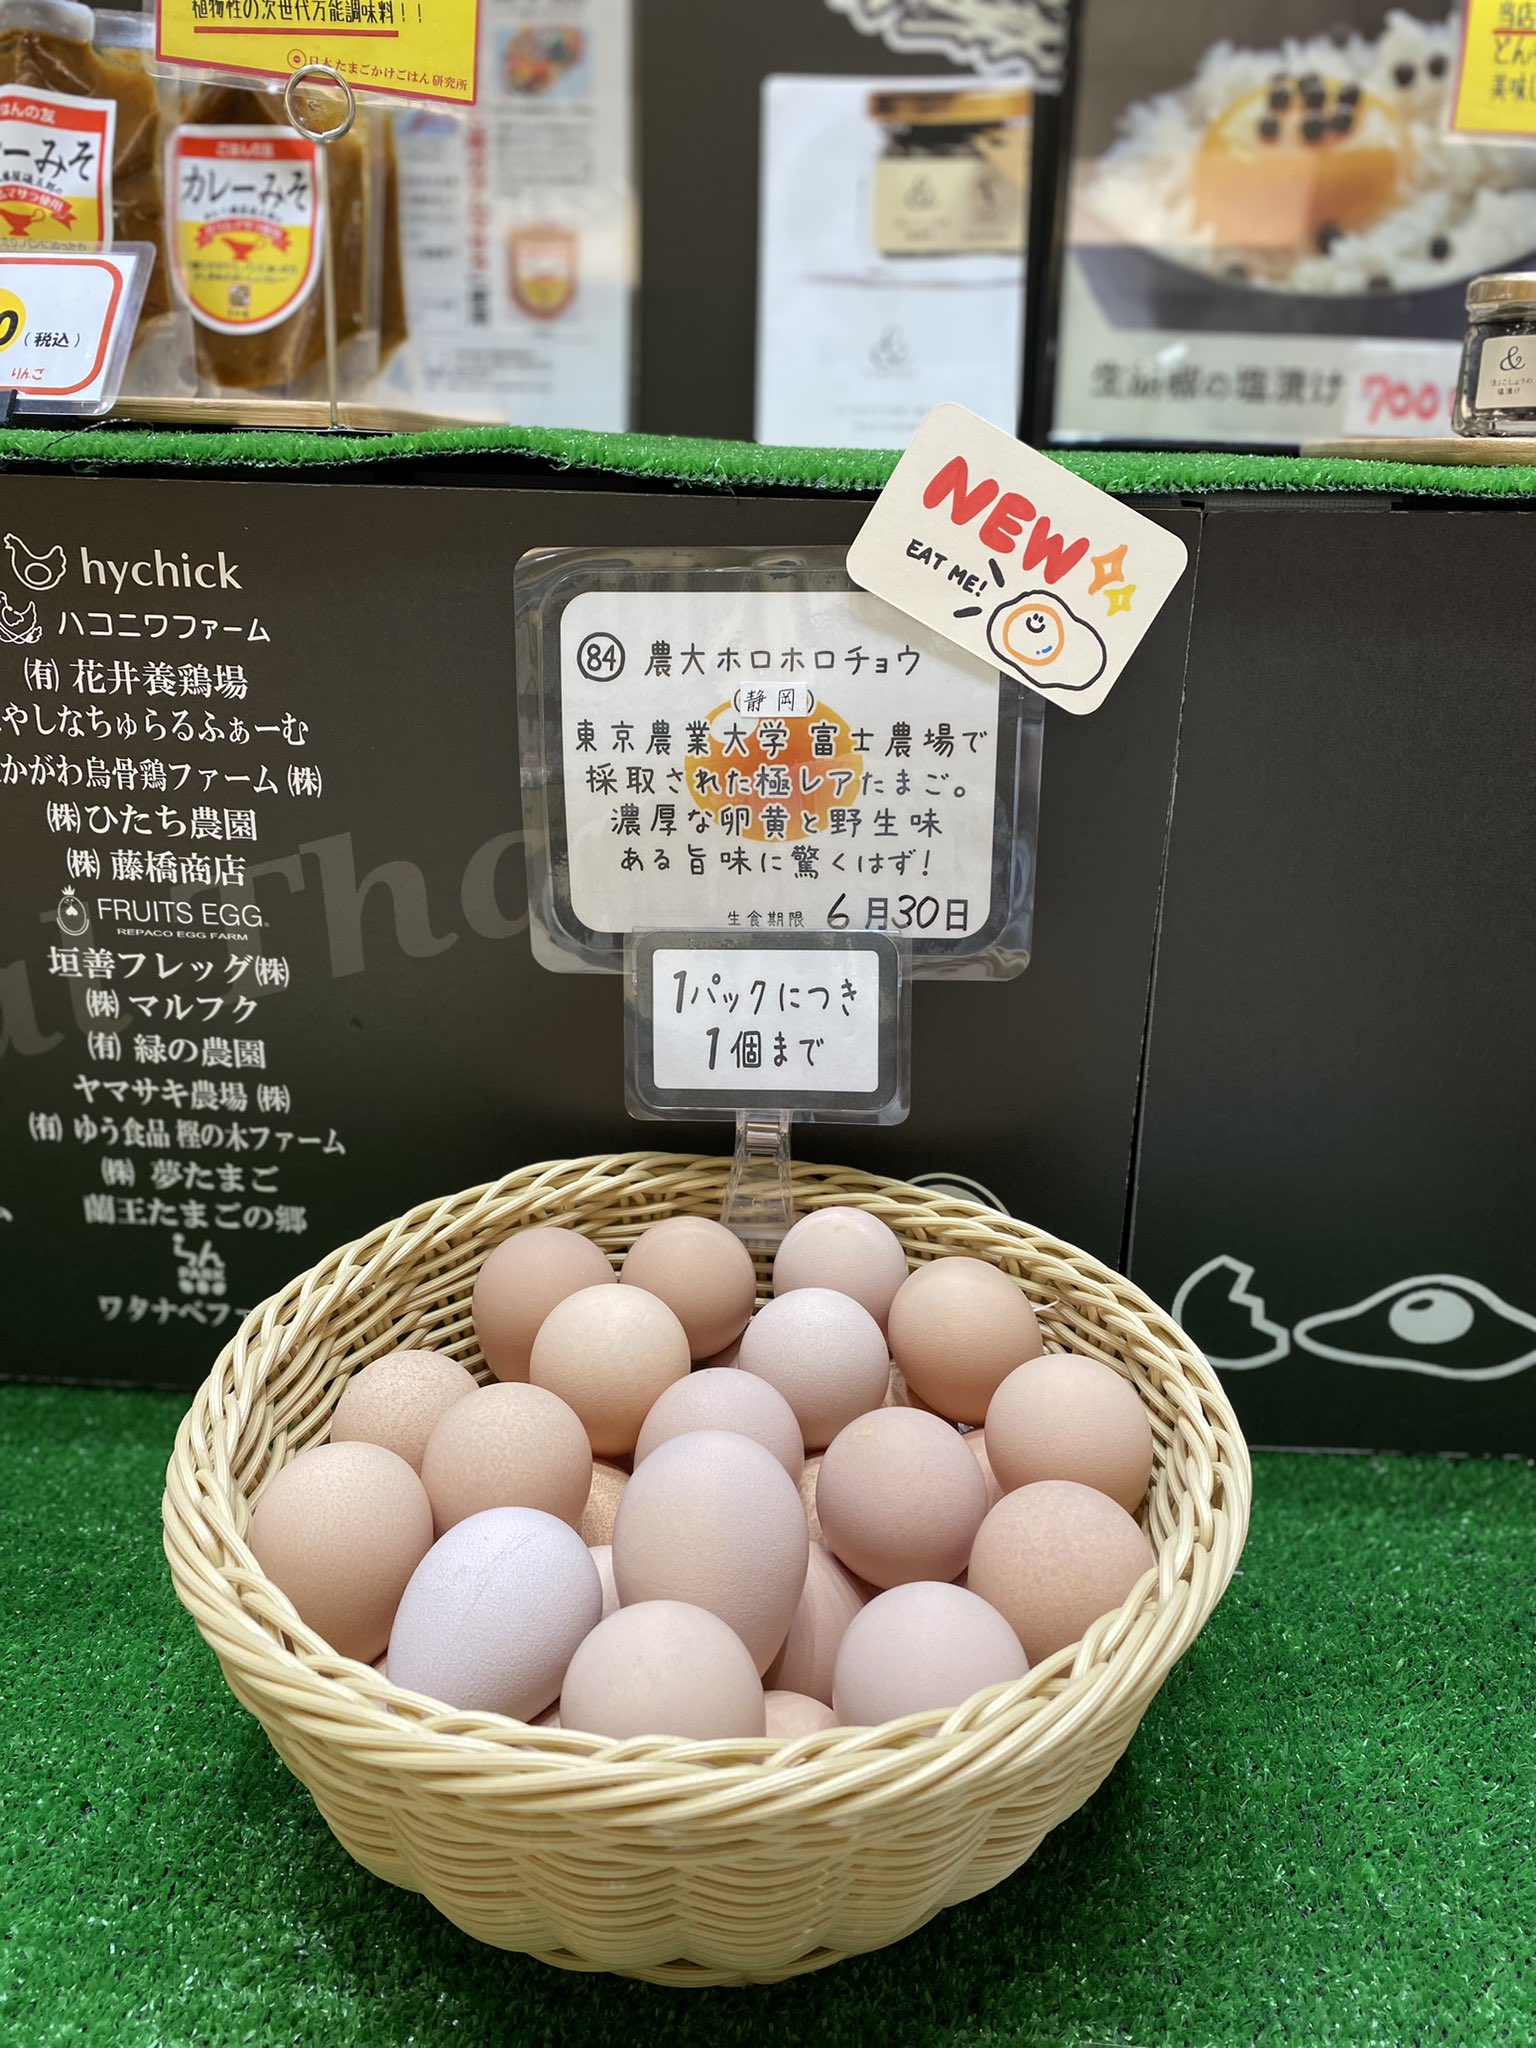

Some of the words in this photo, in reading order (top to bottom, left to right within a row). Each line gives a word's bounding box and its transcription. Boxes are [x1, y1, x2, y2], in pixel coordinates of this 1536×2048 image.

[0, 138, 94, 181] ーみそ
[181, 165, 308, 213] カレーみそ
[24, 331, 80, 348] (税込)
[11, 367, 45, 380] りんご
[1499, 346, 1526, 371] &
[1363, 373, 1457, 425] 700
[923, 456, 1090, 584] NEW
[80, 547, 243, 594] hychick
[906, 538, 948, 570] EAT
[948, 565, 988, 597] ME!
[58, 611, 271, 642] ハコニワファーム
[644, 639, 921, 677] 農大ホロホロチョウ
[69, 658, 248, 699] 花井養鶏場
[733, 688, 815, 713] (静岡)
[0, 702, 309, 746] やしなちゅらるふぁーむ
[0, 752, 279, 796] かがわ烏骨鶏ファーム
[586, 762, 967, 799] 採取された極レアたまご。
[611, 804, 943, 839] 濃厚な卵黄と野生味
[110, 849, 246, 886] 藤橋商店
[621, 845, 931, 880] ある旨味に驚くはず！
[97, 898, 193, 924] FRUITS
[728, 910, 805, 928] 生食期限
[827, 893, 969, 932] 6月30日
[117, 928, 173, 938] REPACO
[177, 931, 207, 940] EGG
[210, 932, 248, 941] FARM
[129, 994, 258, 1024] マルフク
[673, 970, 857, 1016] 1パックにつき
[133, 1033, 266, 1069] 緑の農園
[706, 1027, 824, 1070] 1個まで
[74, 1074, 248, 1112] ヤマサキ農場
[74, 1114, 170, 1149] ゆう食品
[151, 1159, 279, 1192] 夢たまご
